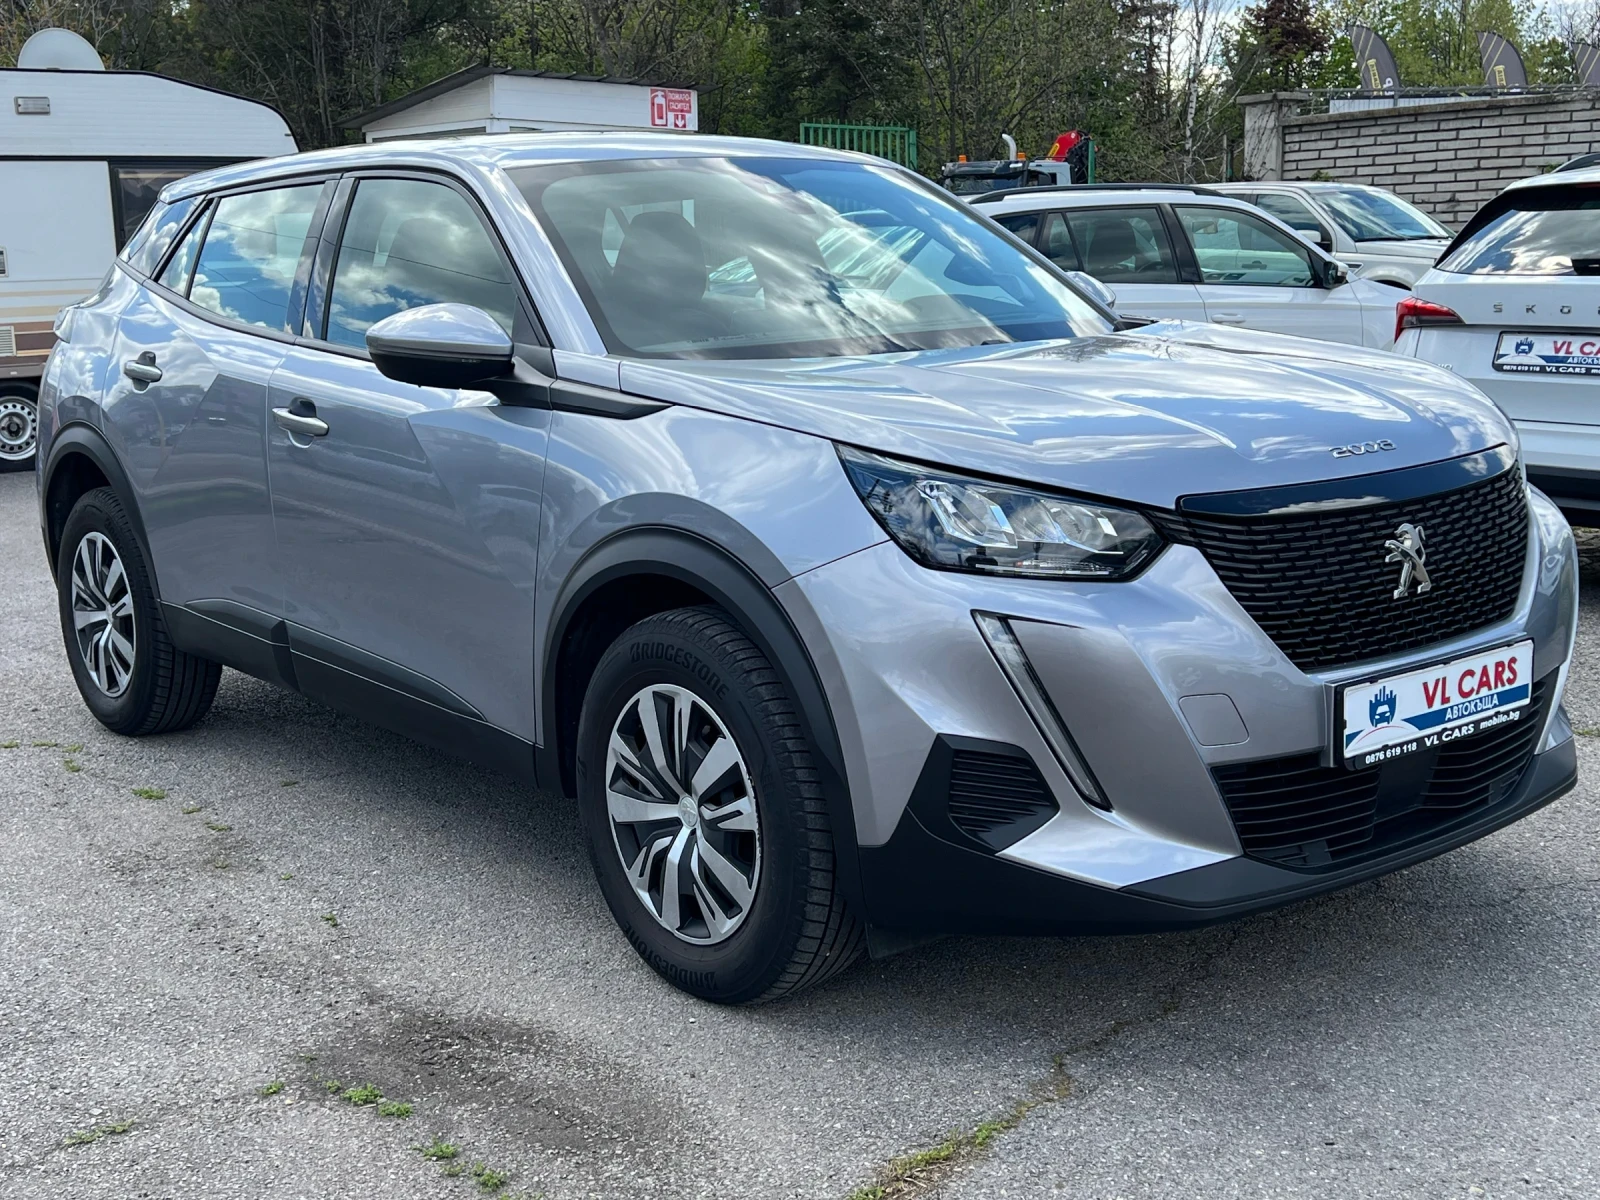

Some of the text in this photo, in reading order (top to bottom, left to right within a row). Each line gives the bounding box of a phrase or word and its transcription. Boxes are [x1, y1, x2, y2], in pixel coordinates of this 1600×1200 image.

[1553, 340, 1573, 355] VL
[1558, 366, 1587, 374] CARS
[1328, 439, 1397, 459] 2008
[629, 641, 731, 701] BRIDGESTONE
[1422, 656, 1519, 709] VL CARS
[1445, 693, 1499, 722] АВТОКЪЩА
[1365, 709, 1521, 765] 0876 619 118 VL CARS mobile.bg
